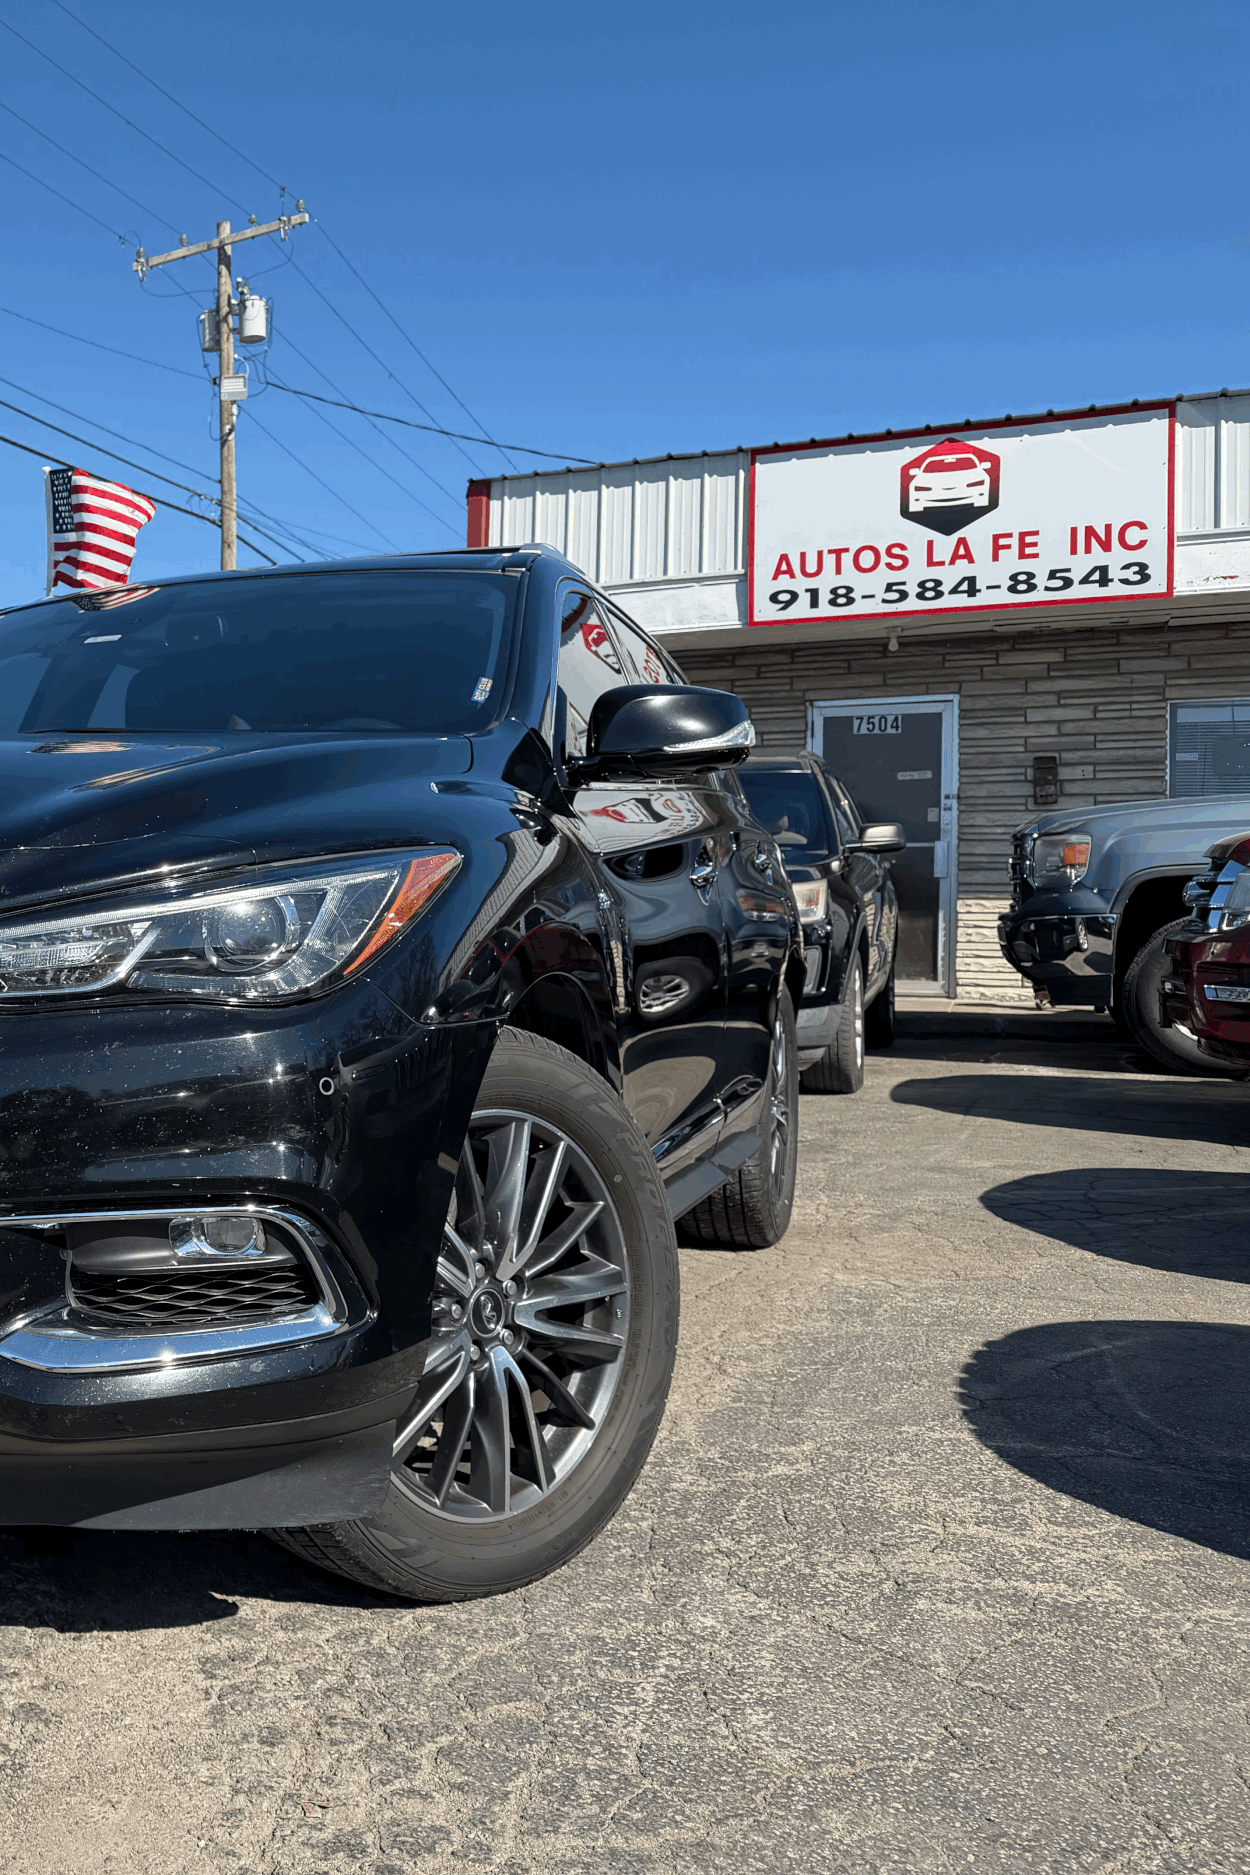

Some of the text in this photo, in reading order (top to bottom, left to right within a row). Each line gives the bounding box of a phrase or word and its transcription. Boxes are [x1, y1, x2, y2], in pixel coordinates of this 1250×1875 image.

[771, 520, 1149, 581] AUTOS LA FE INC
[768, 561, 1152, 611] 918-584-8543
[855, 715, 900, 733] 7504
